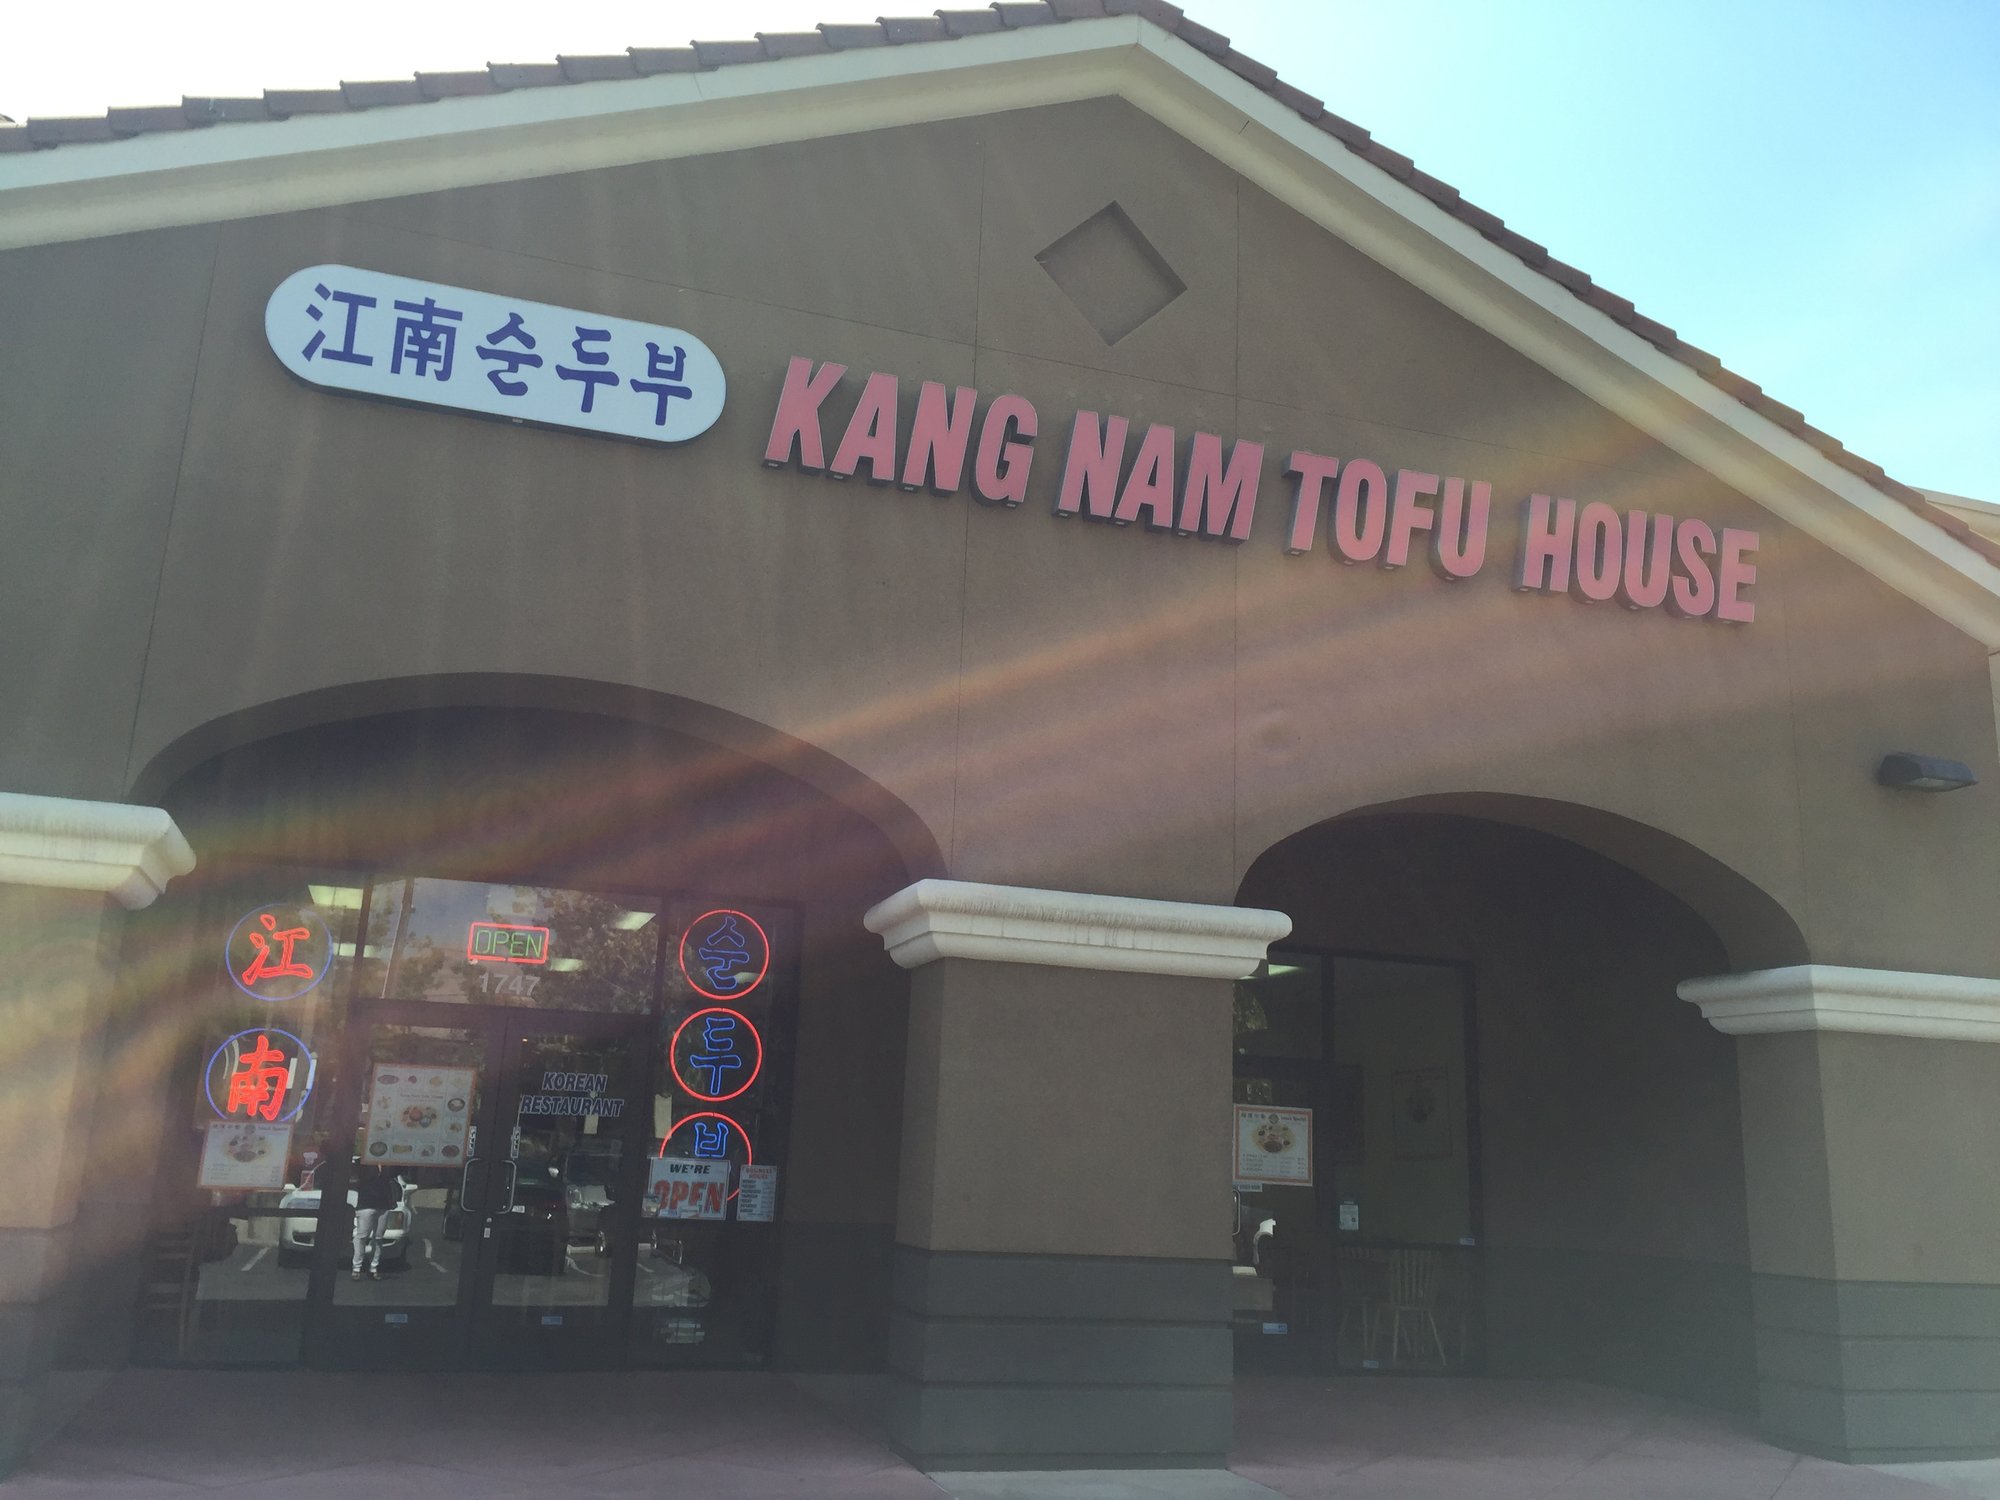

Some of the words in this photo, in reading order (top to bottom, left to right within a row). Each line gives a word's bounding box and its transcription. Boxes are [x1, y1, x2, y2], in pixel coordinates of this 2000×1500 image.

[764, 355, 1039, 504] KANG
[1057, 409, 1265, 541] NAM
[1287, 450, 1492, 578] TOFU
[1522, 493, 1760, 623] HOUSE
[475, 929, 542, 957] OPEN
[479, 972, 541, 996] 1747
[541, 1071, 608, 1092] KOREAN
[520, 1095, 624, 1117] RESTAURANT
[669, 1163, 711, 1174] WE'RE
[653, 1179, 725, 1214] OPEN
